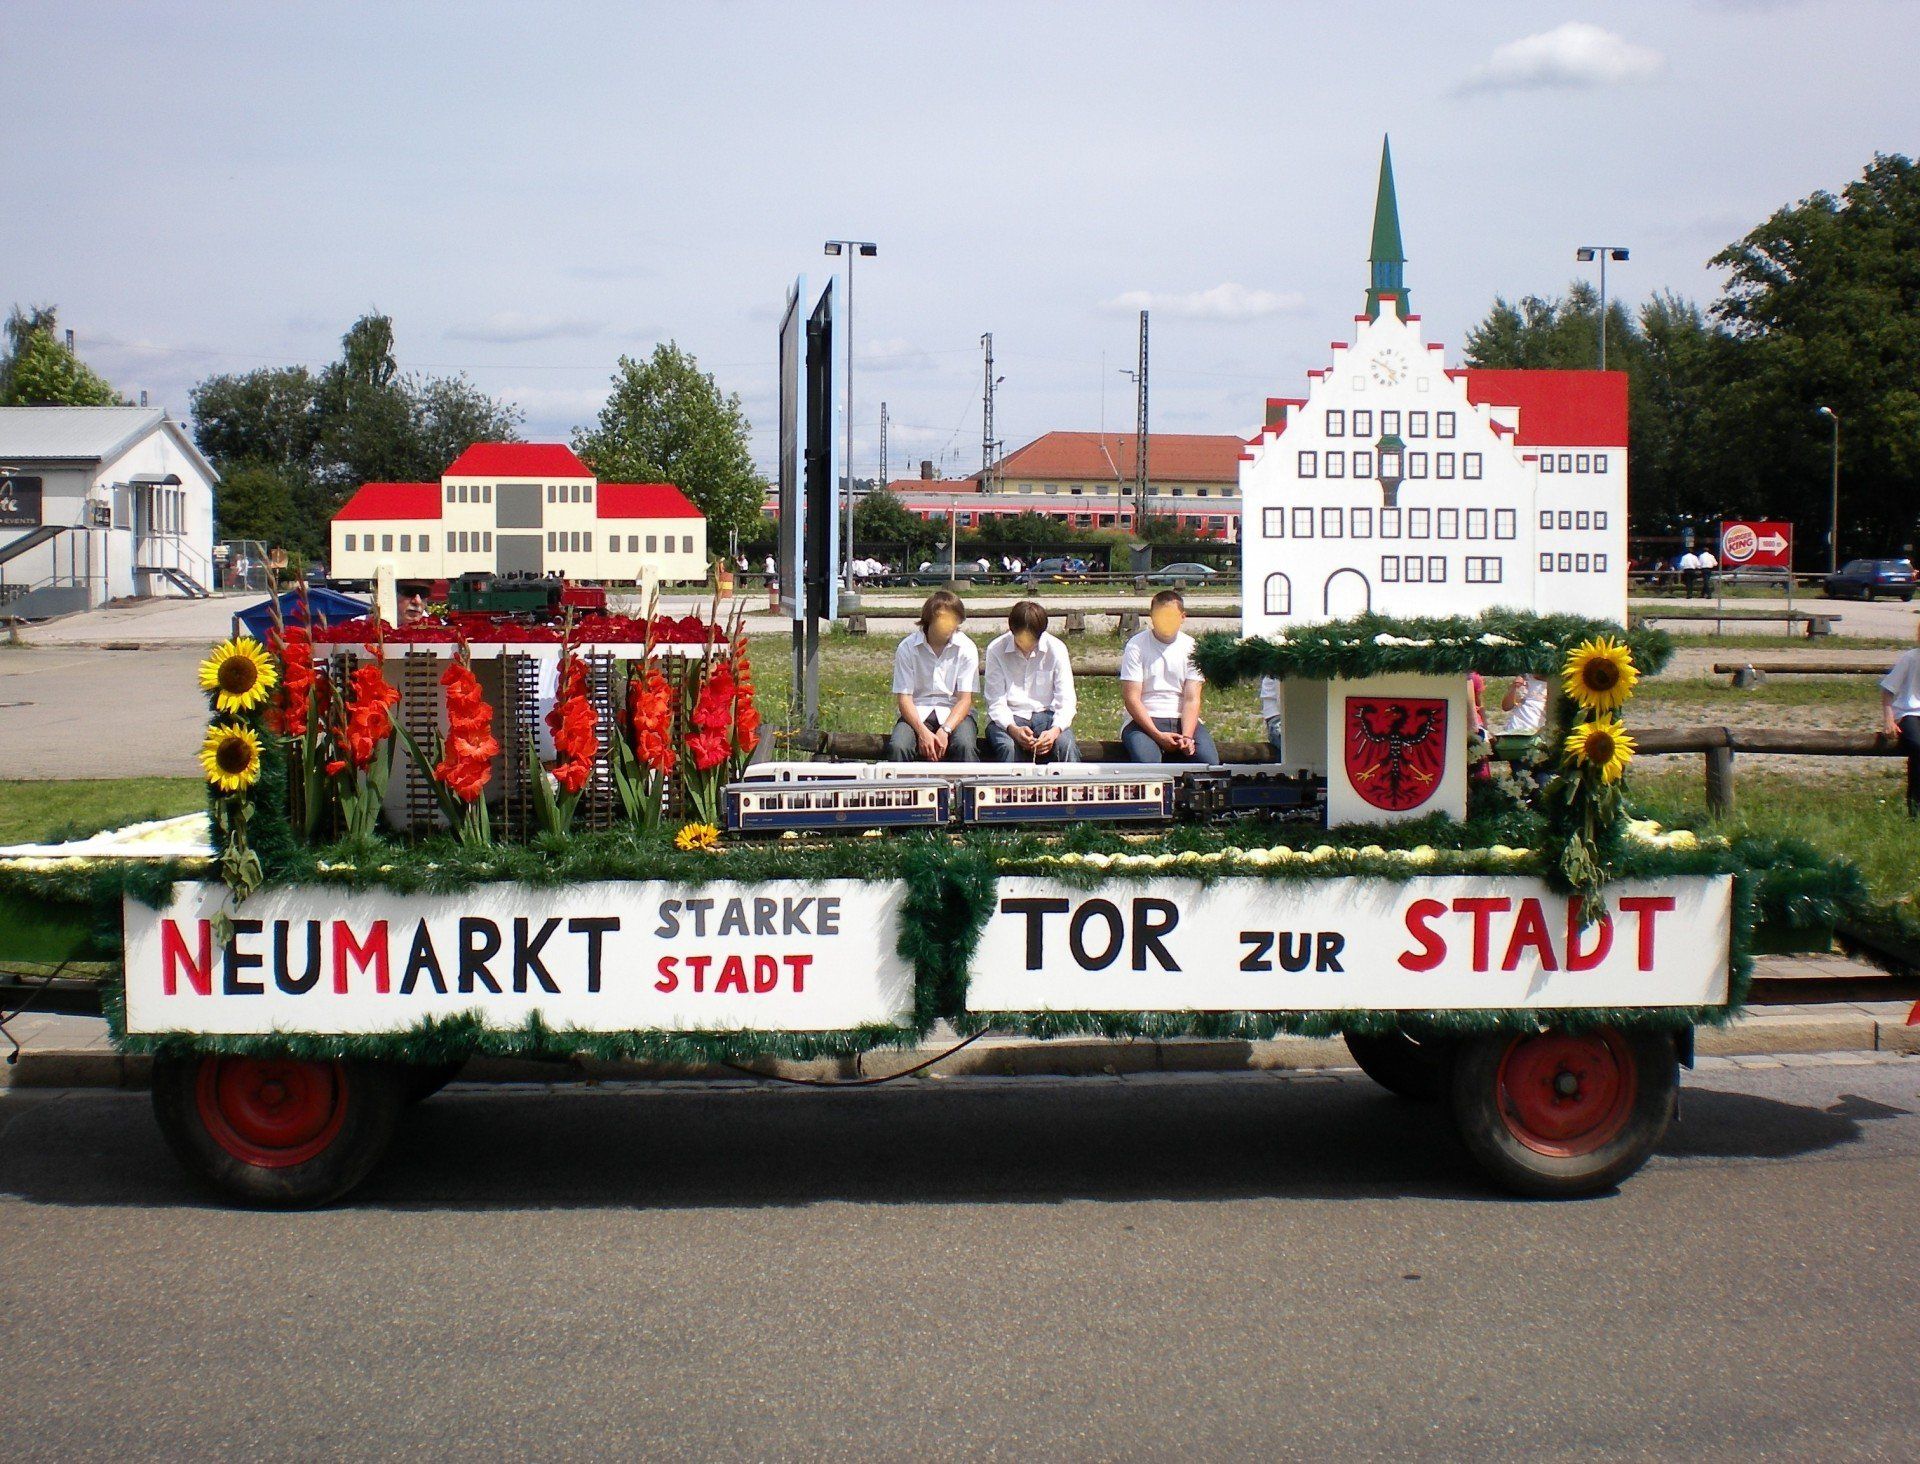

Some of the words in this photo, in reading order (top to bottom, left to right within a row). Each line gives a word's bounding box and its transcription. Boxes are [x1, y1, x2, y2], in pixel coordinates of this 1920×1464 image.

[1727, 531, 1752, 544] BURGER
[1729, 538, 1753, 551] KING
[653, 897, 841, 938] STARKE
[1000, 897, 1181, 972] TOR
[1239, 931, 1345, 973] ZUR
[1397, 897, 1676, 972] STADT
[161, 916, 620, 996] NEUMARKT
[654, 954, 813, 993] STADT
